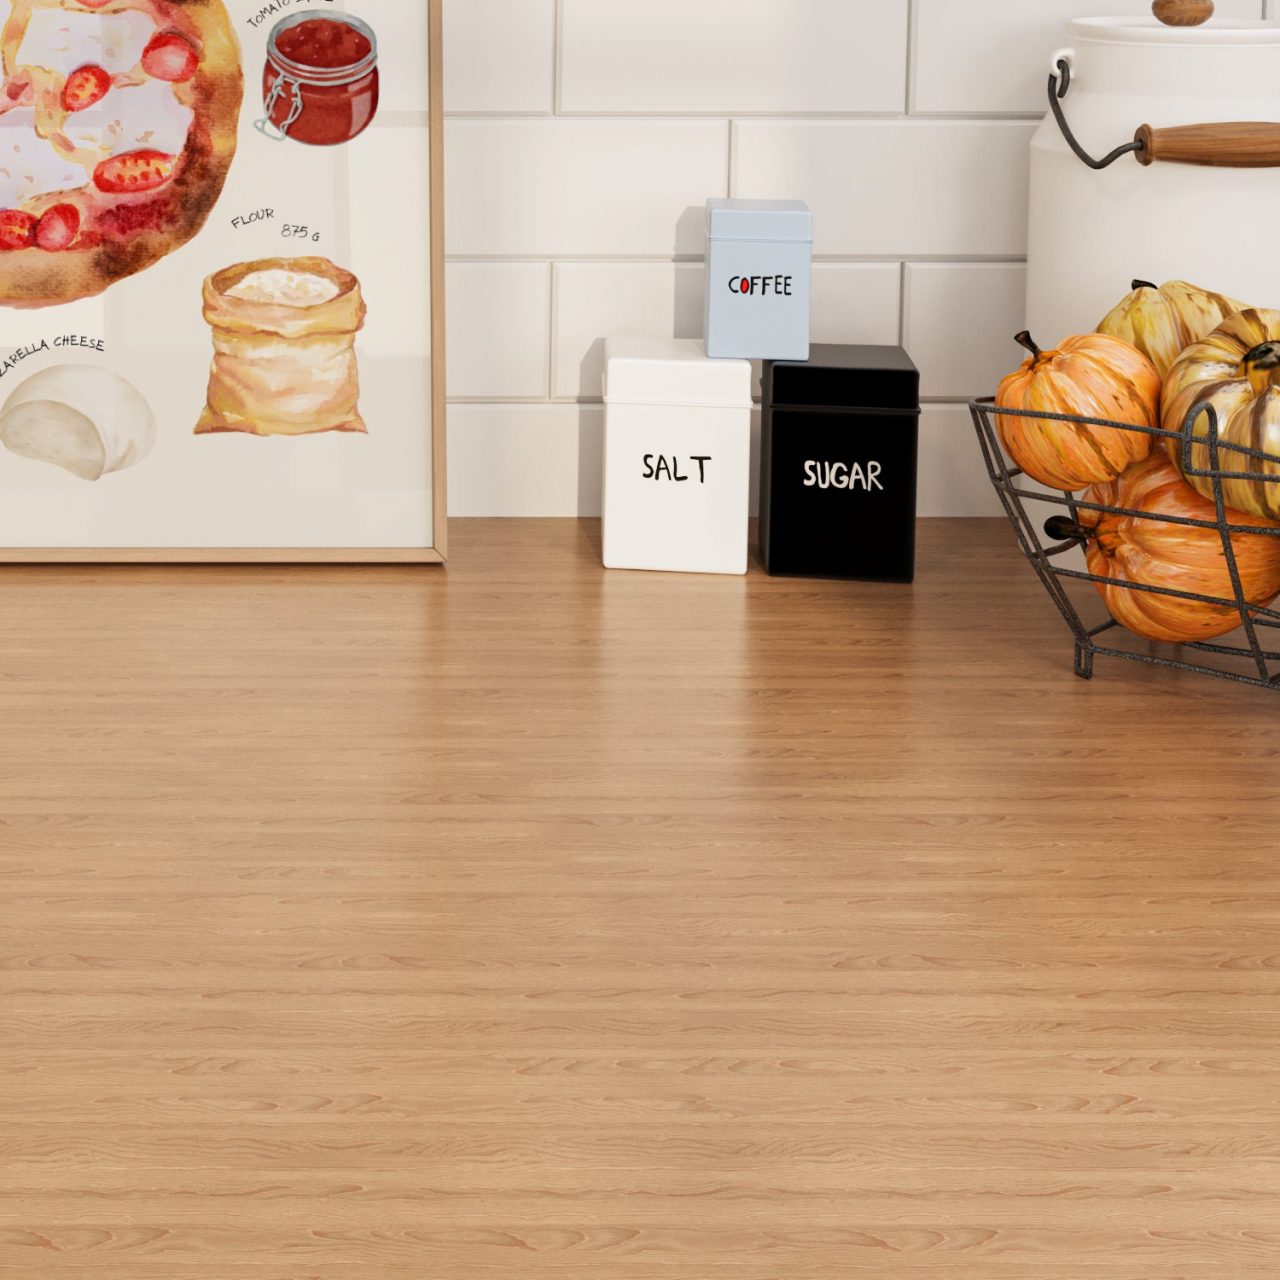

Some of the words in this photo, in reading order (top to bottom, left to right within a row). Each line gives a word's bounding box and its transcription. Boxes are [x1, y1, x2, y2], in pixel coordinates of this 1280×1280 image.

[231, 209, 273, 228] FLOUR
[281, 224, 308, 238] 875
[312, 232, 320, 241] G
[728, 275, 792, 295] COFFEE
[54, 335, 104, 351] CHEESE
[643, 454, 711, 483] SALT
[803, 460, 883, 491] SUGAR
